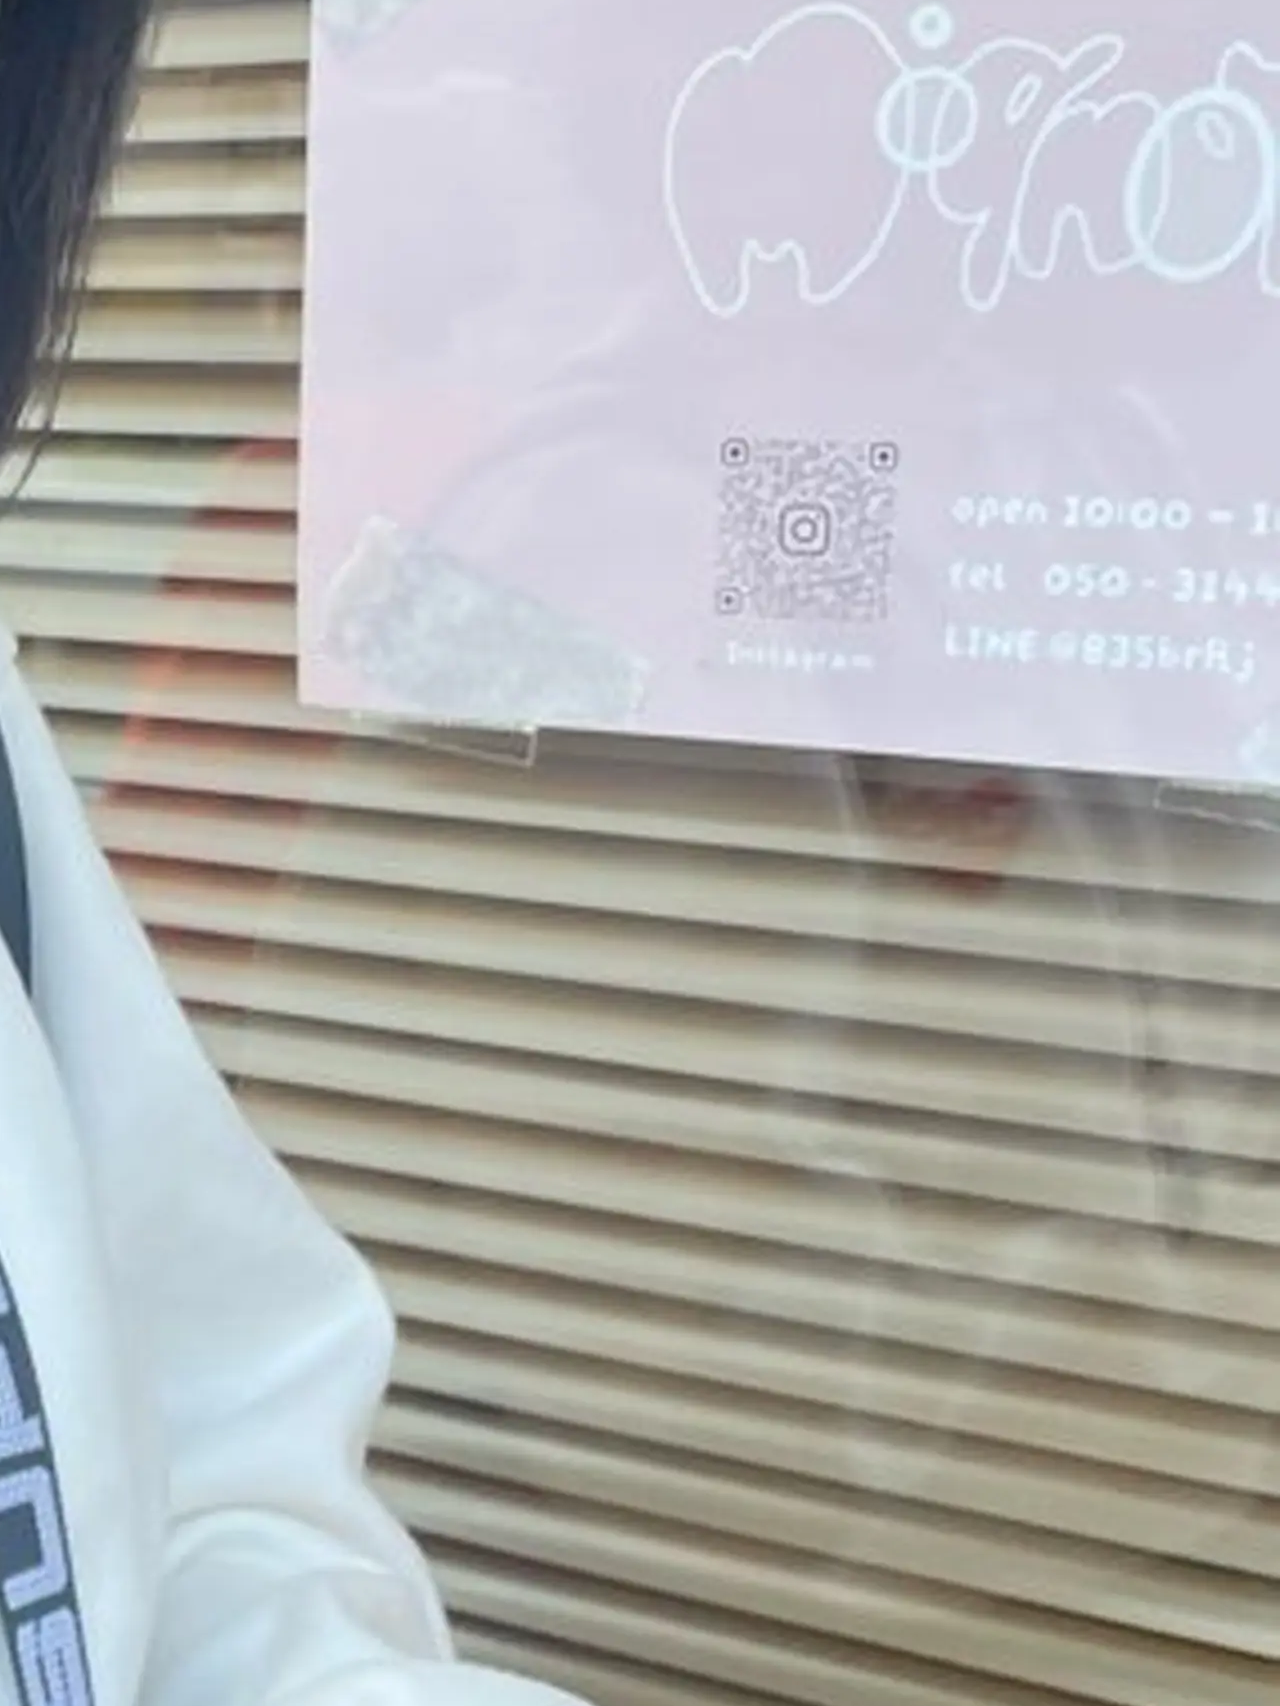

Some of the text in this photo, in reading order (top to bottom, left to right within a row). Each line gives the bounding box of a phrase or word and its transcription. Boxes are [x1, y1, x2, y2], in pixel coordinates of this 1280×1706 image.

[951, 496, 1048, 529] open
[1063, 495, 1193, 531] 10:00
[948, 561, 1007, 592] tel
